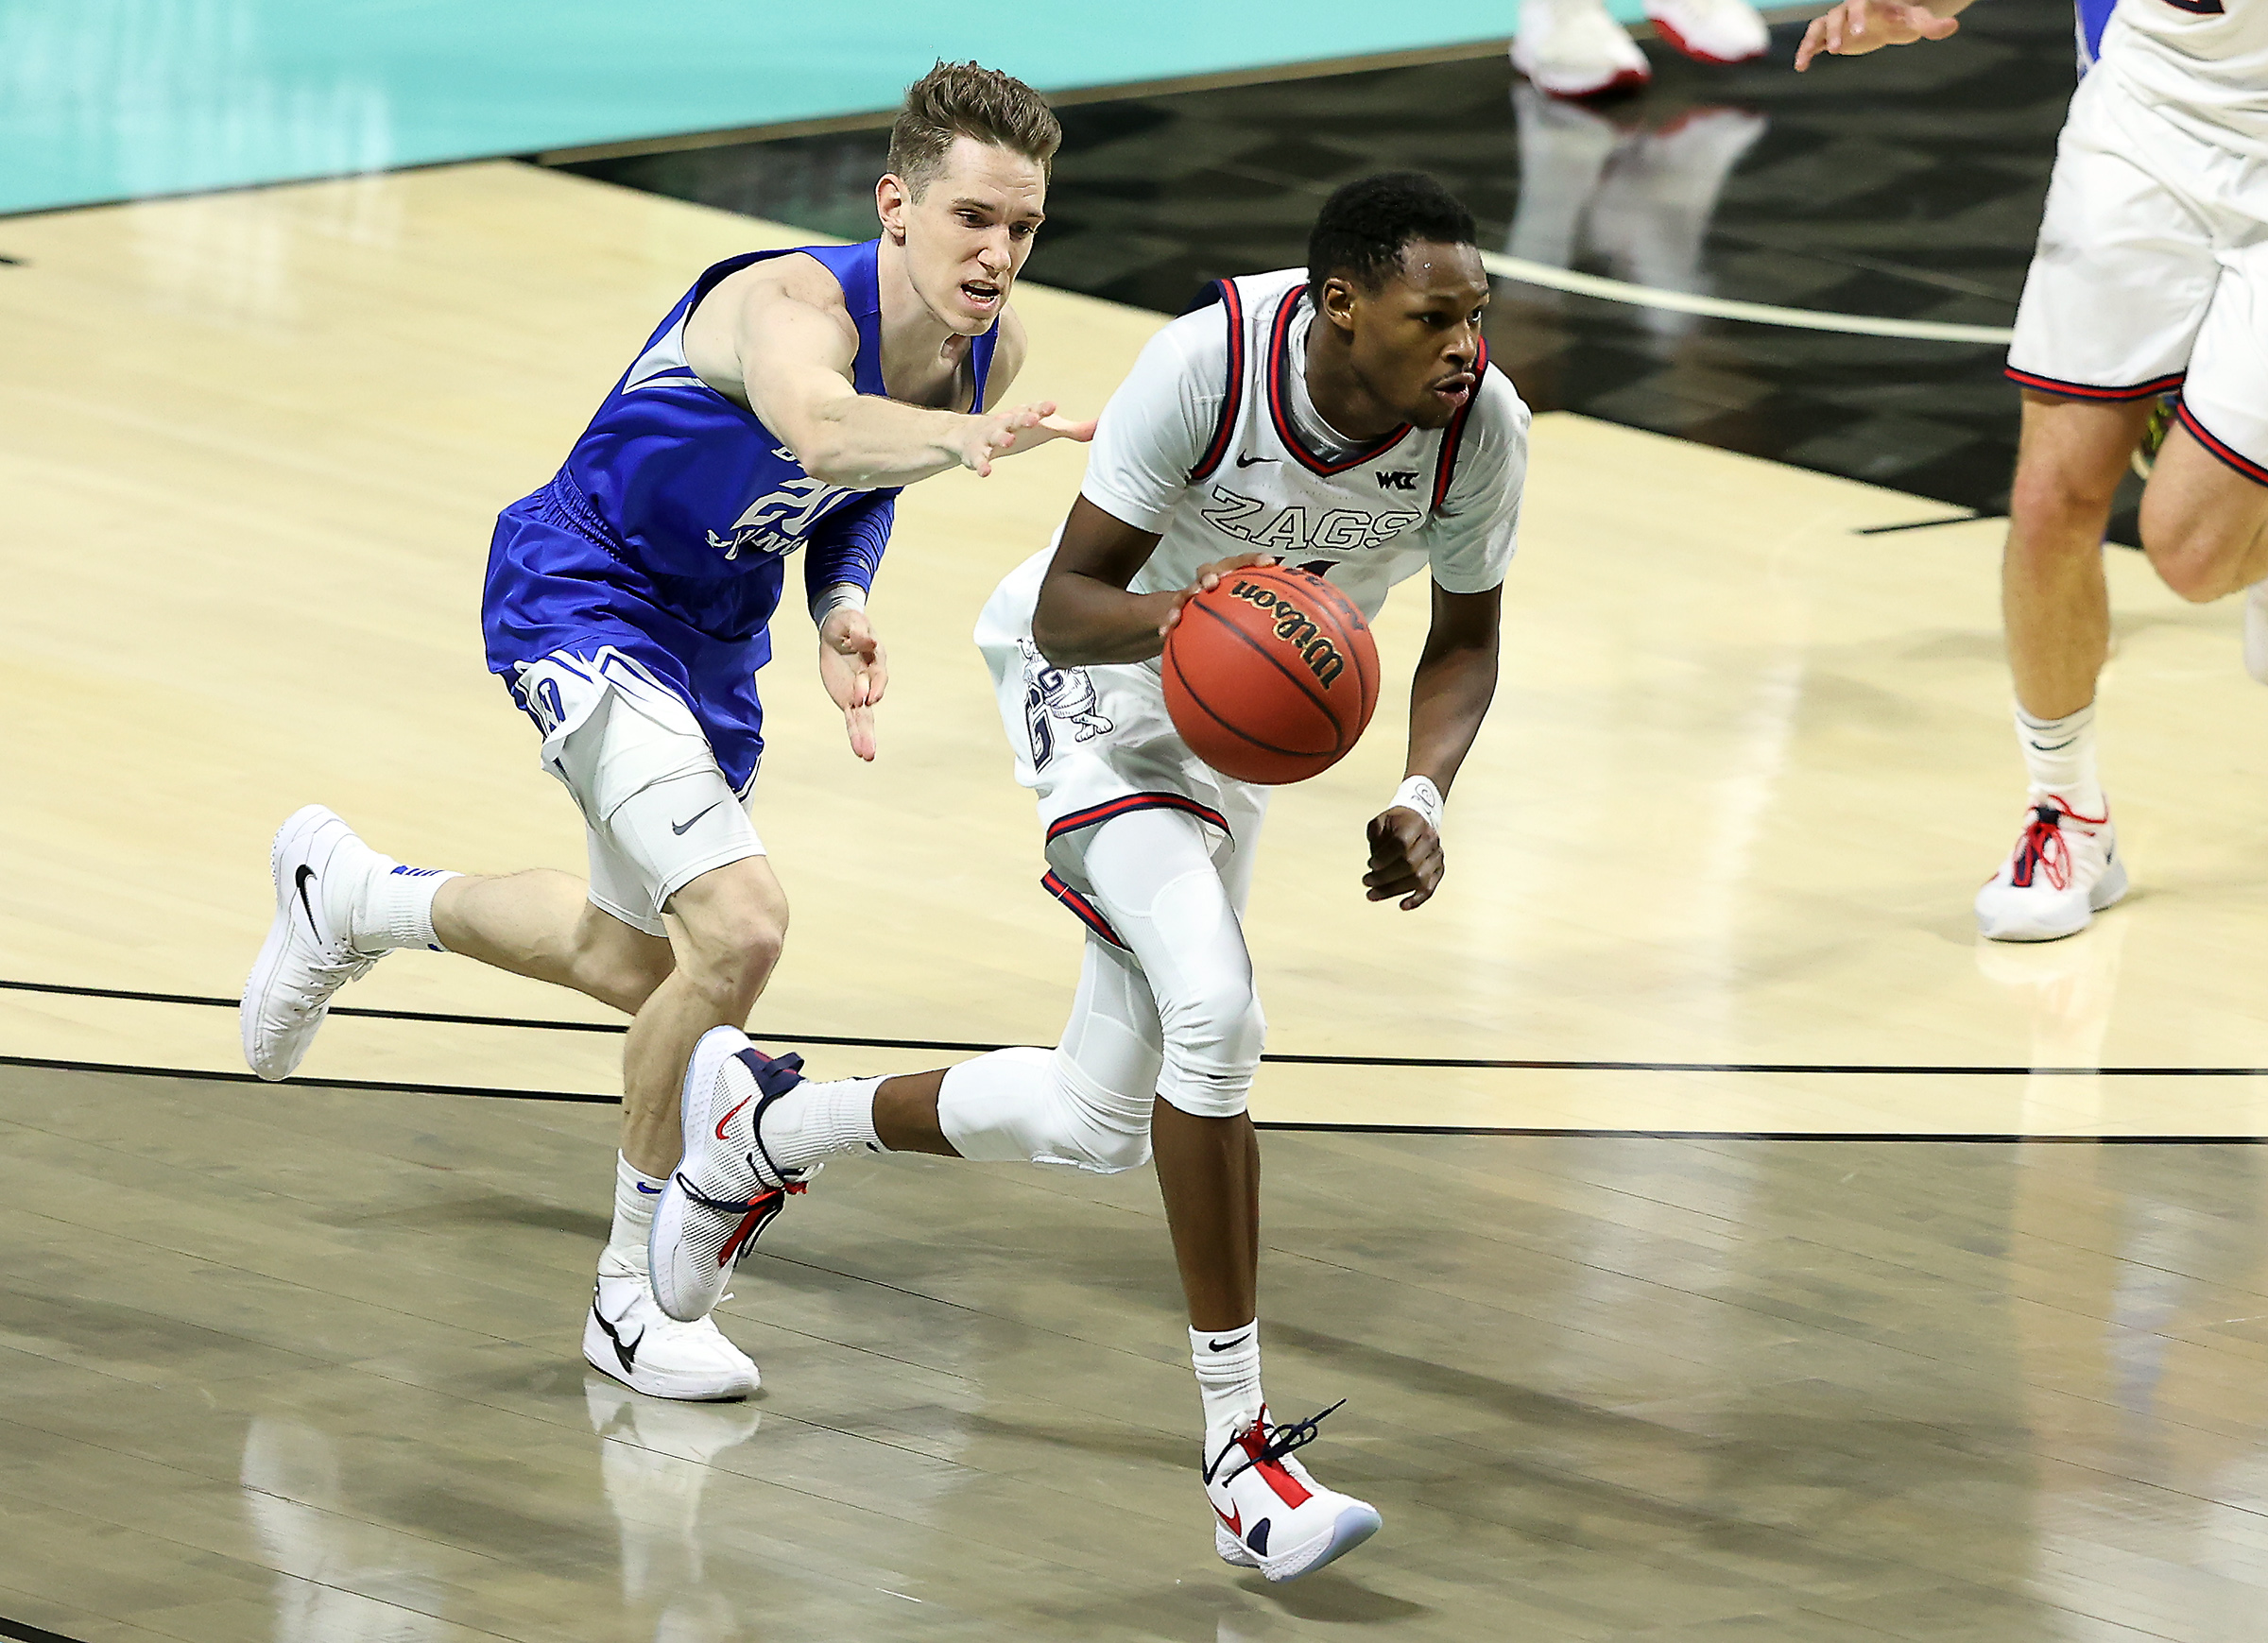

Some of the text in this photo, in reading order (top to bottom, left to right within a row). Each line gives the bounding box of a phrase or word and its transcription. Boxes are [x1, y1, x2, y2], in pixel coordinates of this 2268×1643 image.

[1375, 471, 1419, 489] WCC
[1201, 485, 1421, 550] ZAGS
[1230, 579, 1344, 691] Wilson
